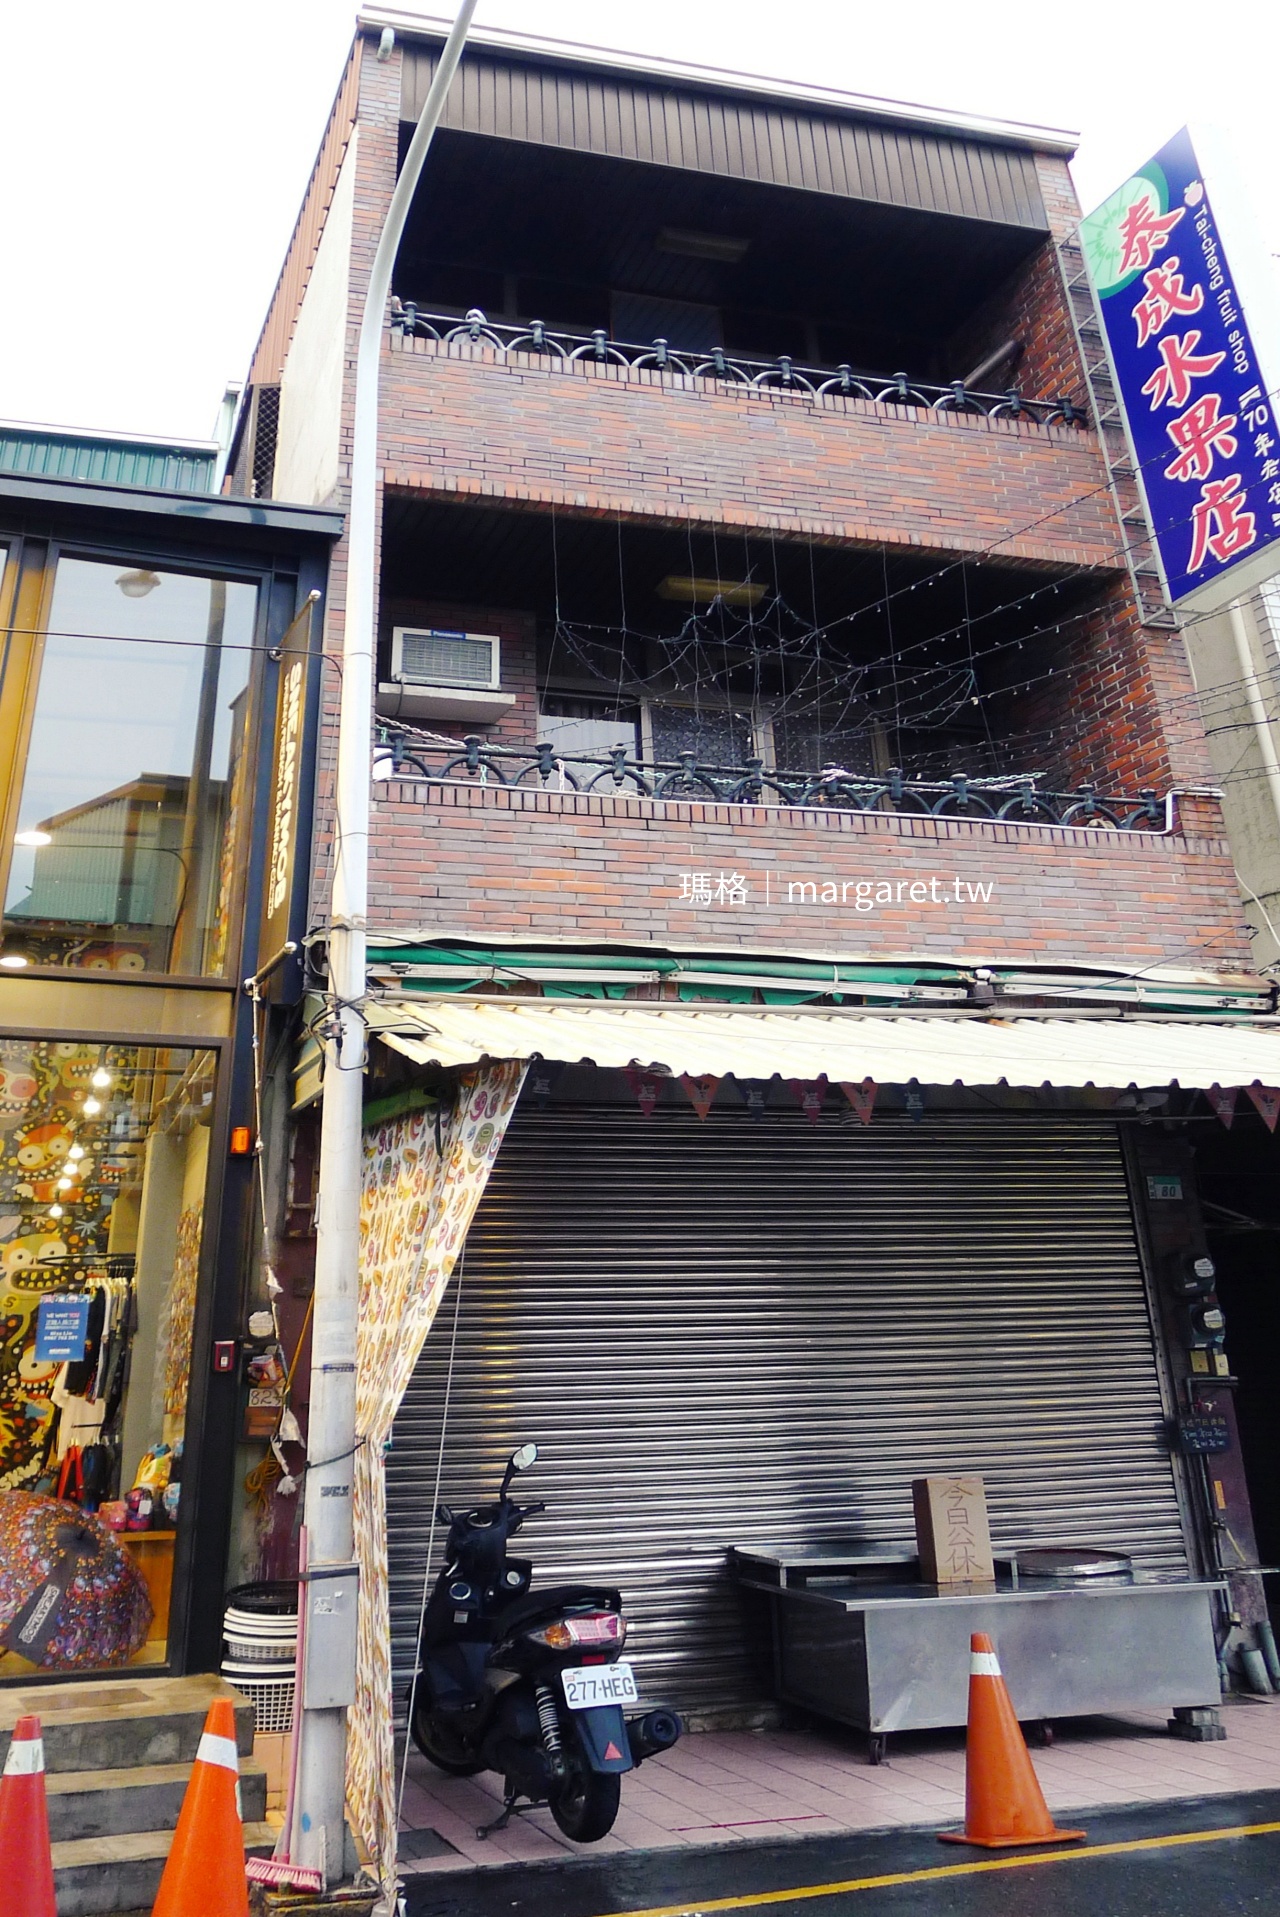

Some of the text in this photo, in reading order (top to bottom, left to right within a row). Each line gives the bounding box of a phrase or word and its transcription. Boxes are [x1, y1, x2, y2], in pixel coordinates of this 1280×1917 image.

[1193, 204, 1249, 374] Tai-cheng fruit shop
[1117, 194, 1256, 574] 泰成水果店
[274, 661, 302, 909] SNEAKYMOB
[23, 1587, 58, 1642] SNEAKYMOB
[939, 1485, 984, 1575] 今日公休
